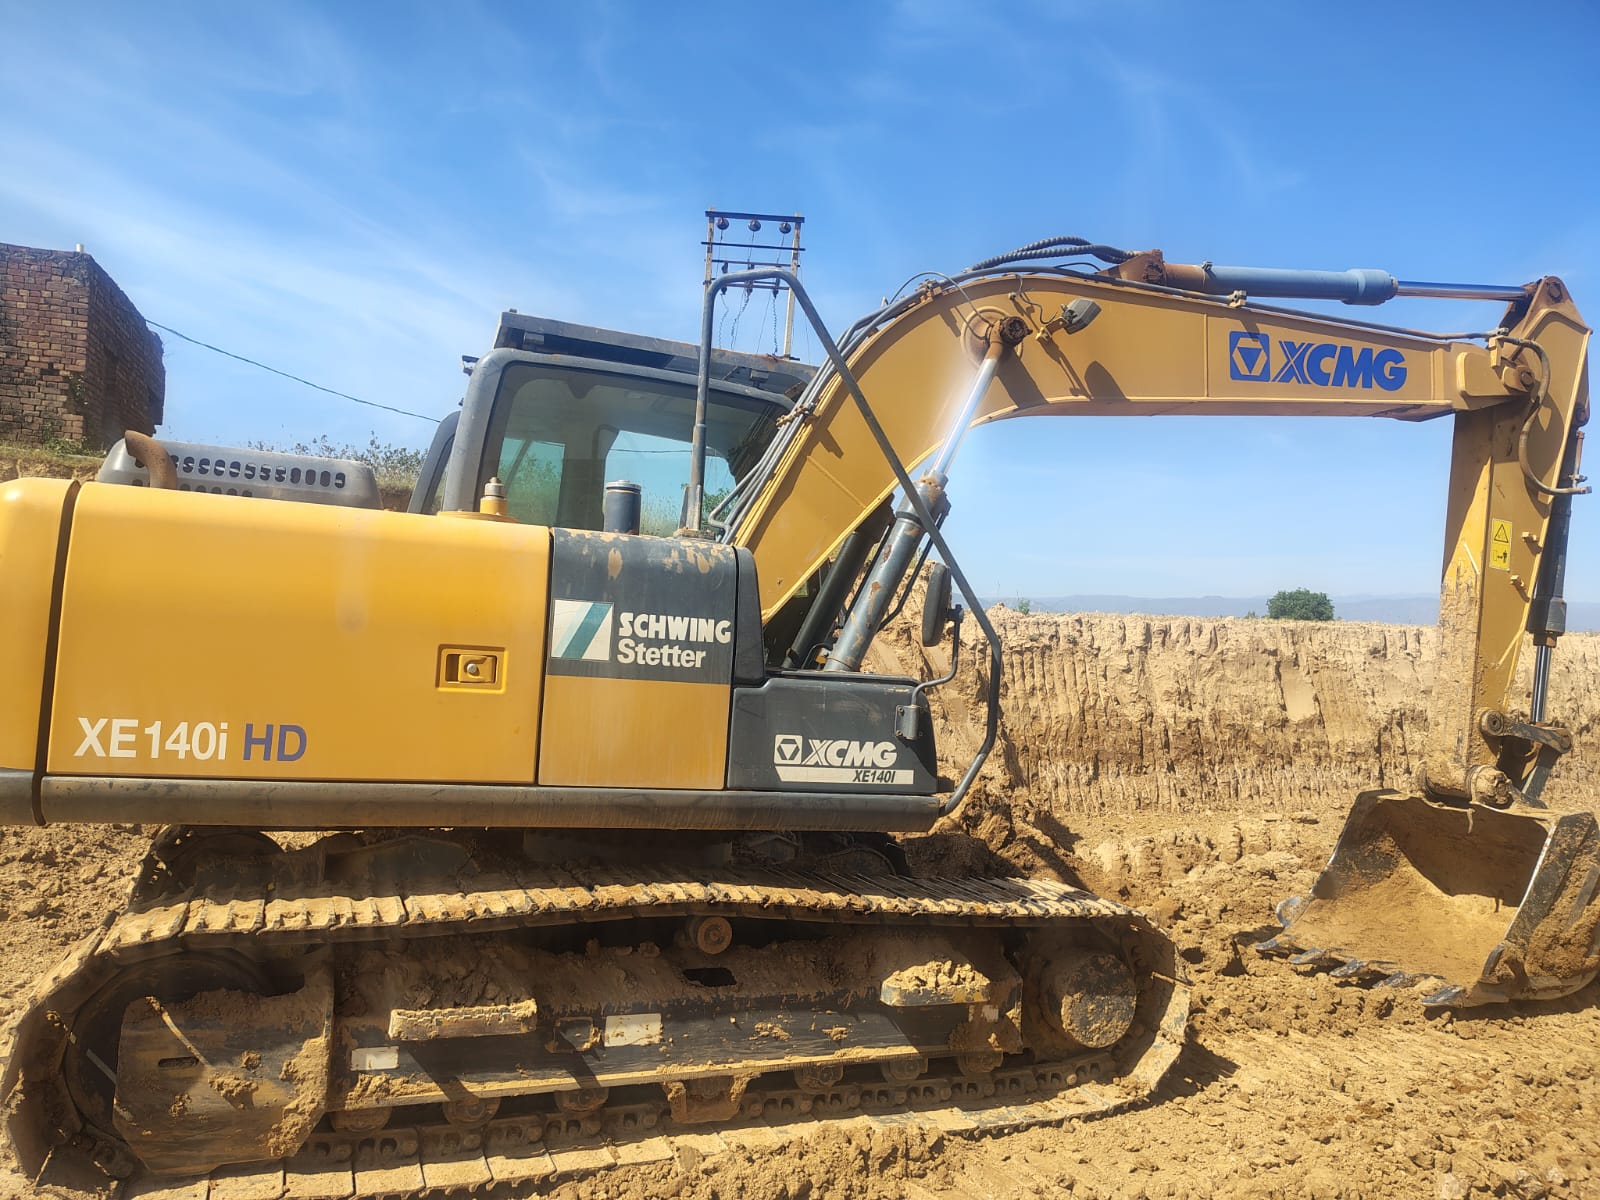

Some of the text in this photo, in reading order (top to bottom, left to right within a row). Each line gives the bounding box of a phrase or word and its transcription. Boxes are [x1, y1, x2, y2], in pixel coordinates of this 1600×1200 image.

[1271, 340, 1408, 392] XCMG
[618, 612, 732, 644] SCHWING
[617, 638, 706, 668] Stetter
[243, 723, 308, 762] HD
[801, 739, 898, 768] XCMG
[853, 769, 896, 784] XE140I
